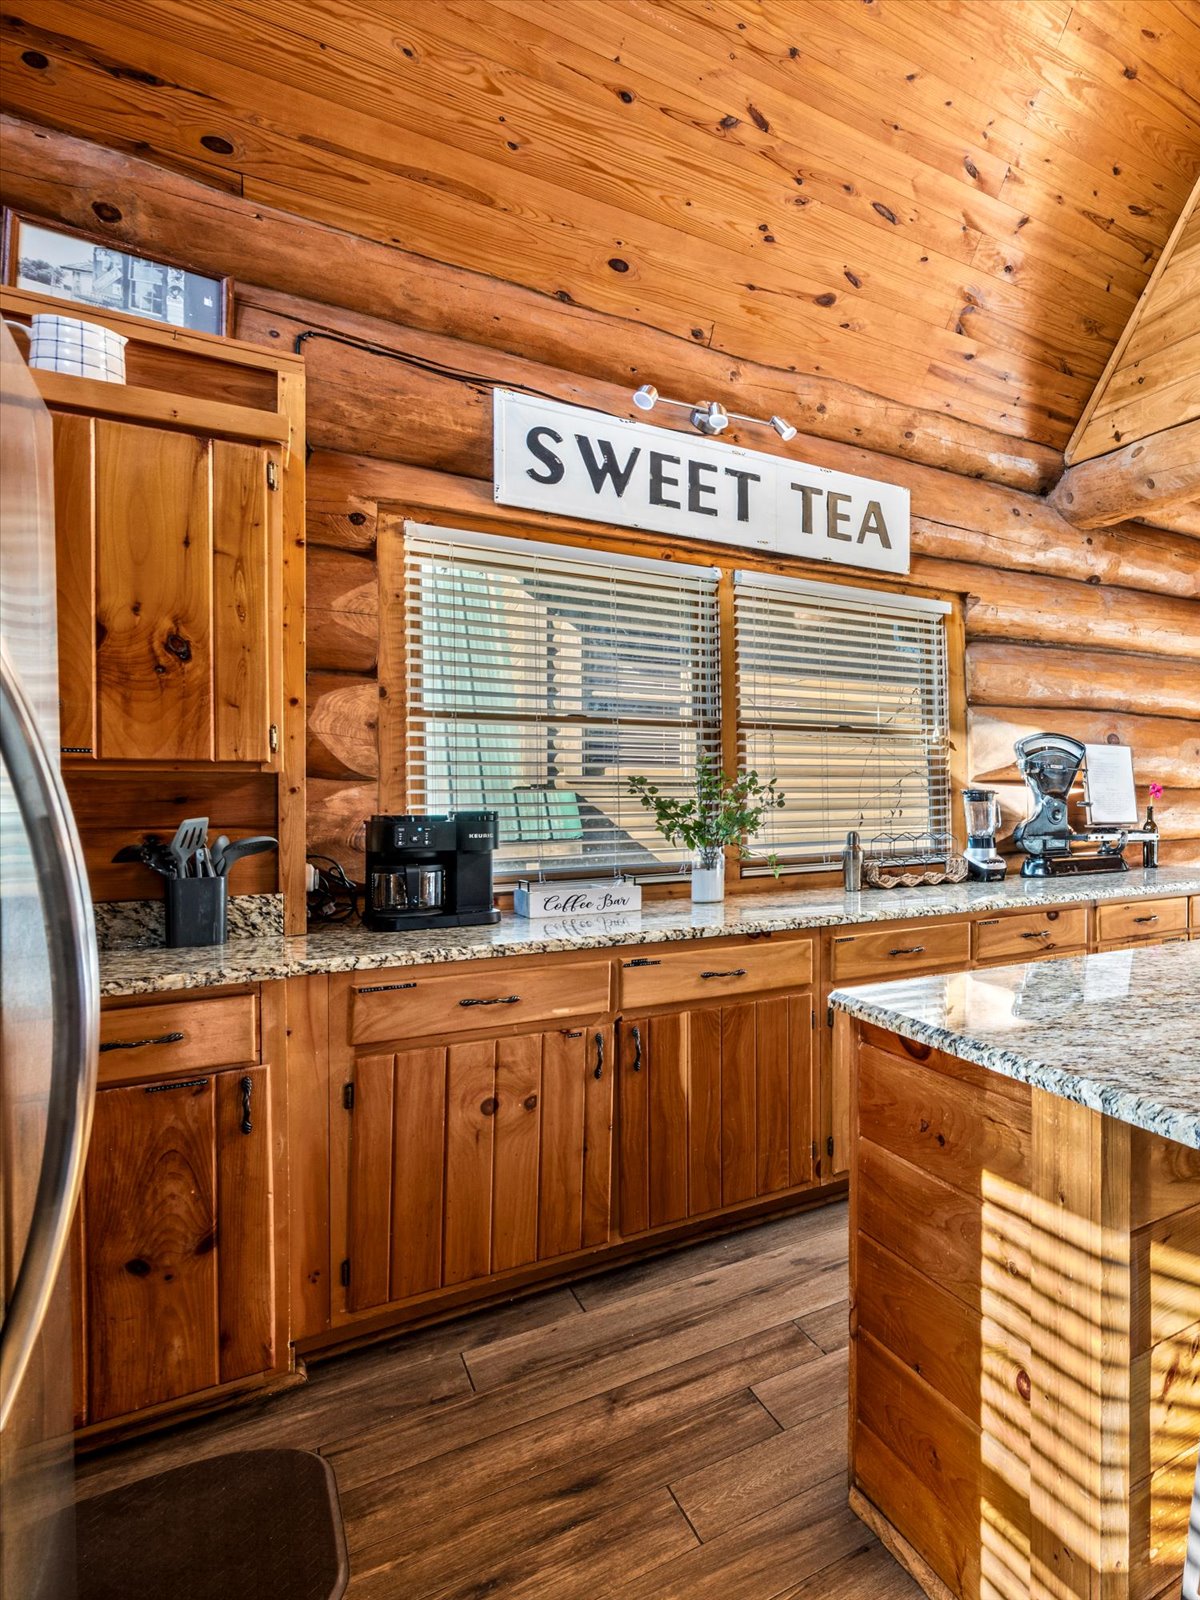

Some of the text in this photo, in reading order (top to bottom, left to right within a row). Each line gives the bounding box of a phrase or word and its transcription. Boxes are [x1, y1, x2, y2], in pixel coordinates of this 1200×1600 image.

[525, 425, 892, 549] SWEET TEA
[543, 893, 631, 912] Coffee Bar
